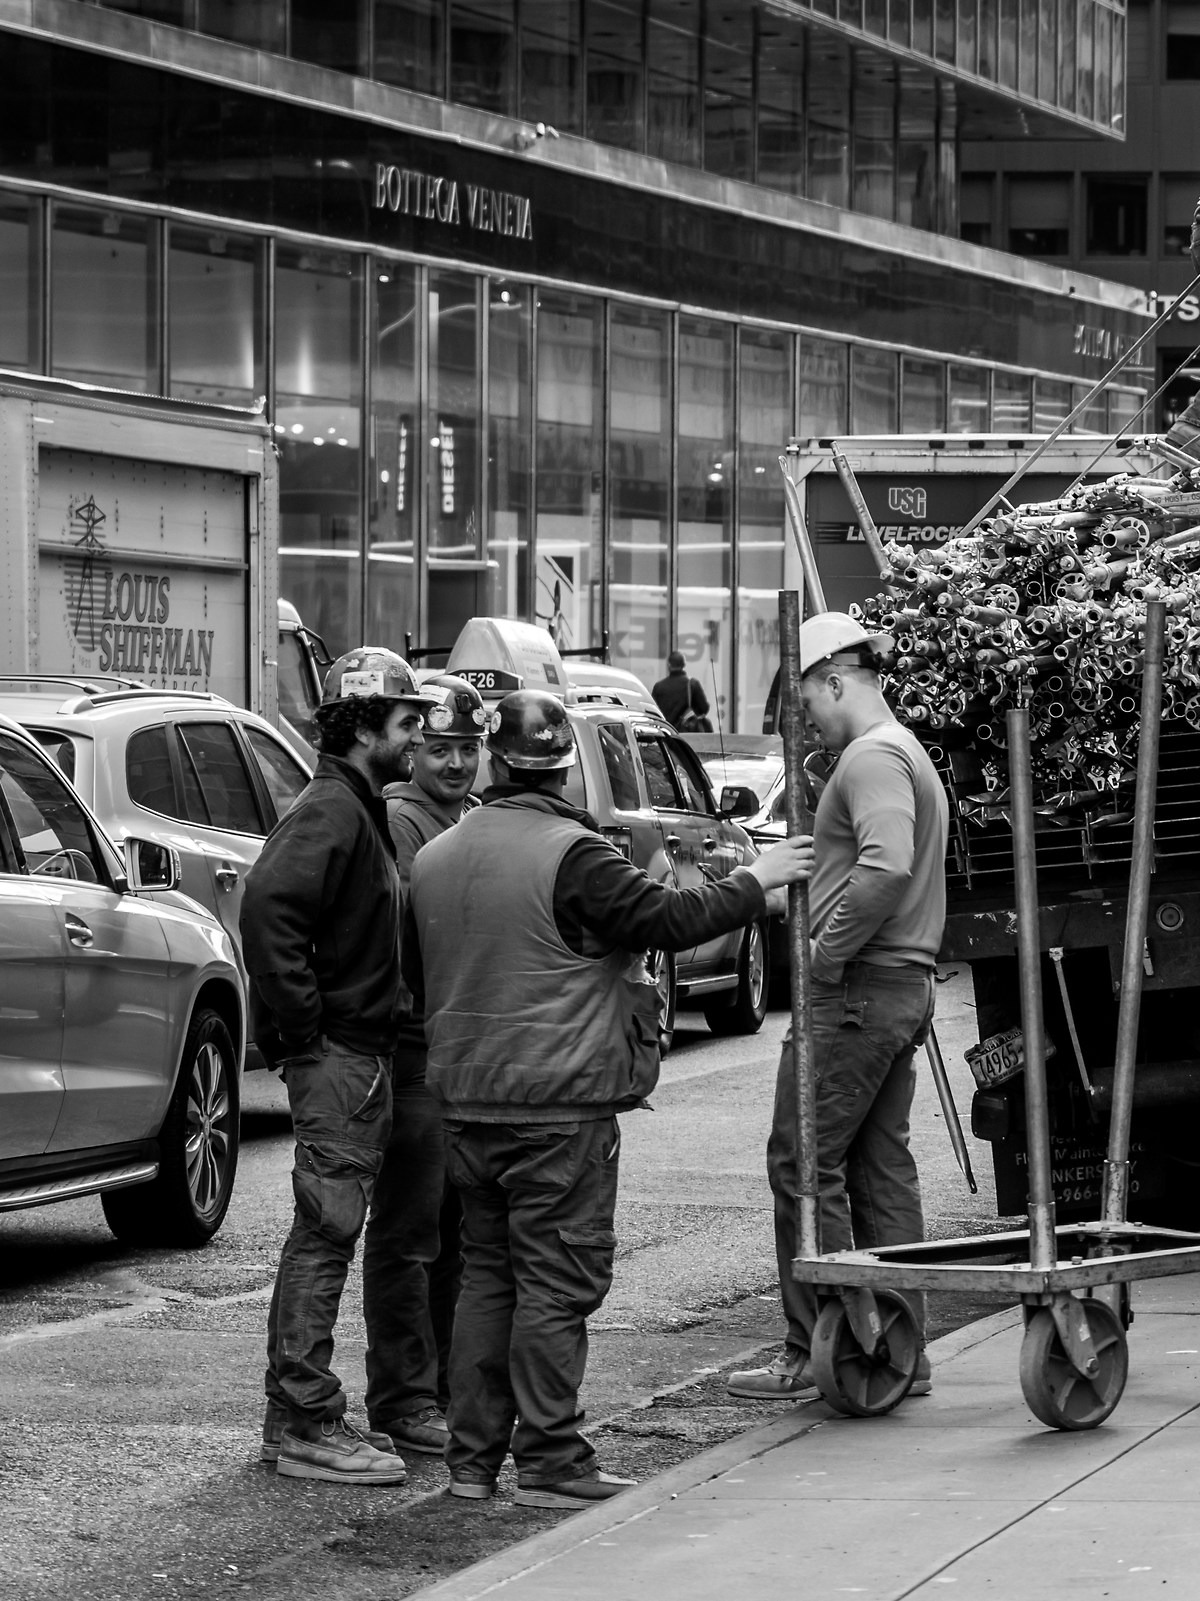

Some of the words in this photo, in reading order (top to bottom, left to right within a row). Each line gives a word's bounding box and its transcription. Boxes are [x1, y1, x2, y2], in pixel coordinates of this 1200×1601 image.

[372, 162, 460, 225] BOTTEGA
[466, 184, 532, 241] VENETA
[889, 487, 927, 518] USG
[847, 526, 965, 541] LVELROCK
[102, 571, 171, 624] LOUIS
[100, 622, 215, 677] SHIFFMAN
[1028, 1164, 1103, 1184] NKERS
